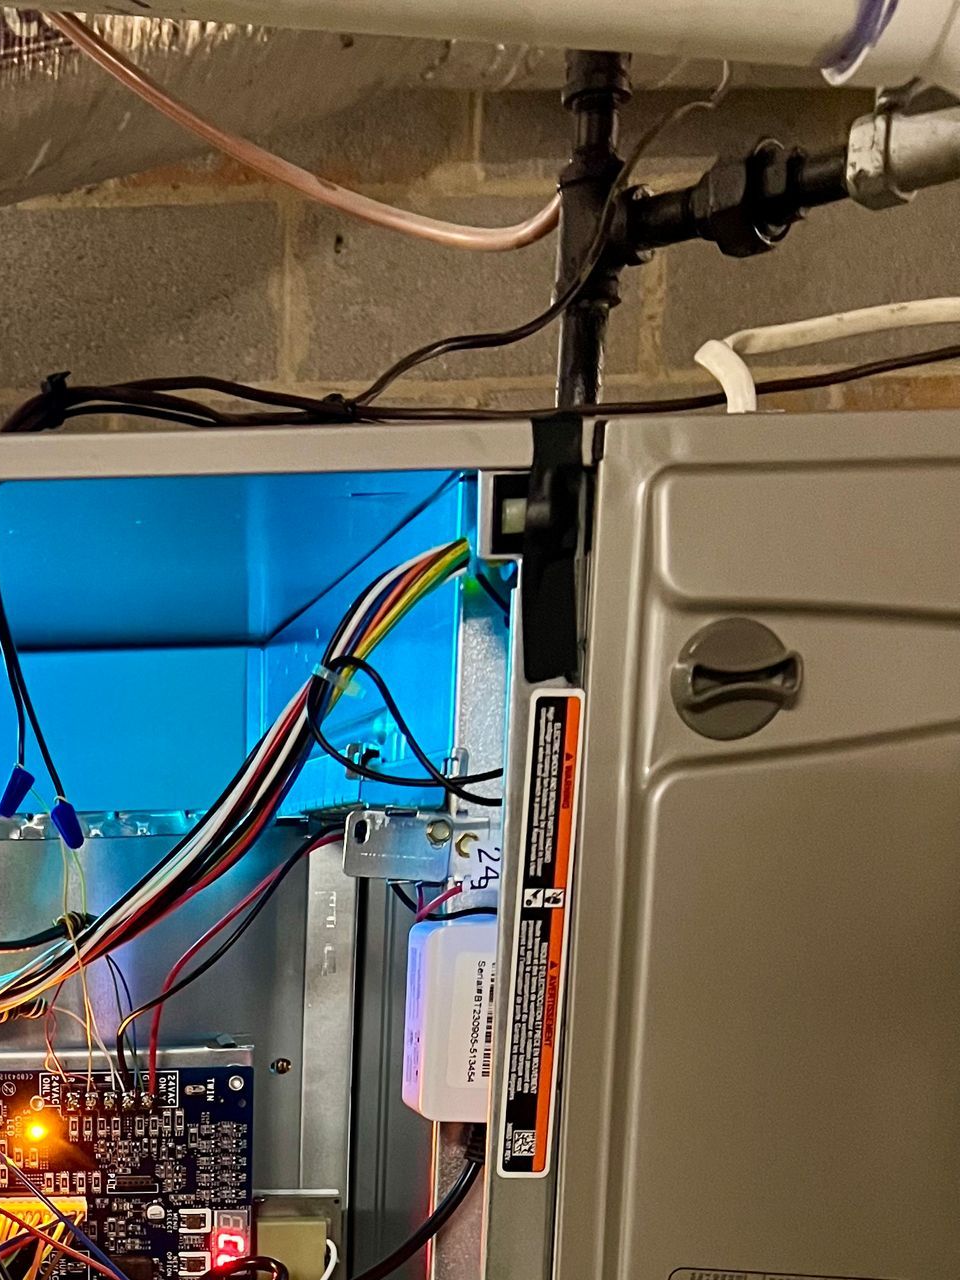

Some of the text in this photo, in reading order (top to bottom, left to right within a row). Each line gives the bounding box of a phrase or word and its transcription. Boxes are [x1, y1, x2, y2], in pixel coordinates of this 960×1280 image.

[42, 1077, 51, 1101] ONLY
[51, 1075, 60, 1105] 24VAC
[159, 1077, 167, 1102] ONLY
[167, 1075, 176, 1105] 24VAC
[206, 1078, 215, 1102] TWIN
